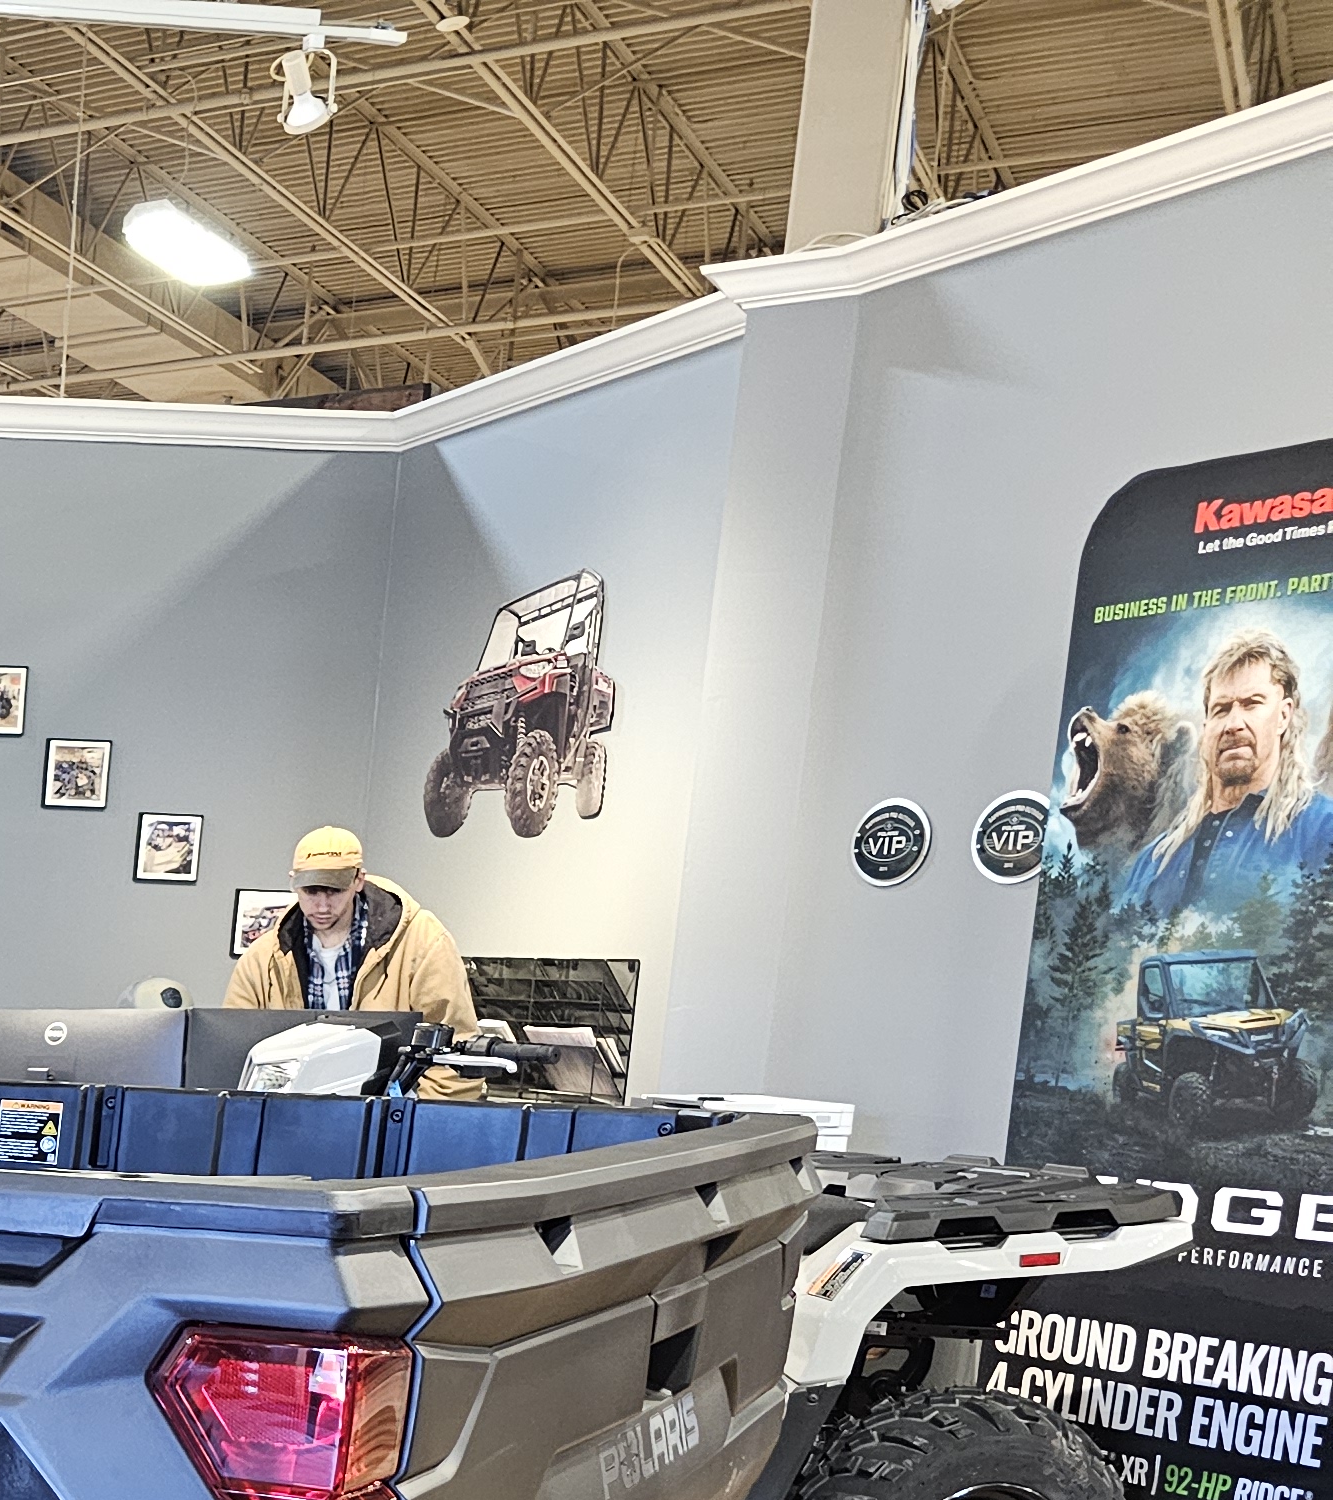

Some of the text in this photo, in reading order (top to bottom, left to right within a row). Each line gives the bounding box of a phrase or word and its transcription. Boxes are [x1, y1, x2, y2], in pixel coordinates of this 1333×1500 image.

[1197, 540, 1220, 554] Let
[1222, 536, 1244, 551] the
[1245, 528, 1282, 547] Good
[1284, 524, 1326, 541] Times
[1094, 572, 1333, 624] BUSINESS IN THE FRONT. PART
[868, 836, 907, 856] VIP
[991, 830, 1034, 851] VIP
[994, 1309, 1333, 1407] GROUND BREAKING
[985, 1361, 1328, 1468] 4-CYLINDER ENGINE
[599, 1391, 700, 1500] POLARIS
[1120, 1454, 1149, 1486] XR
